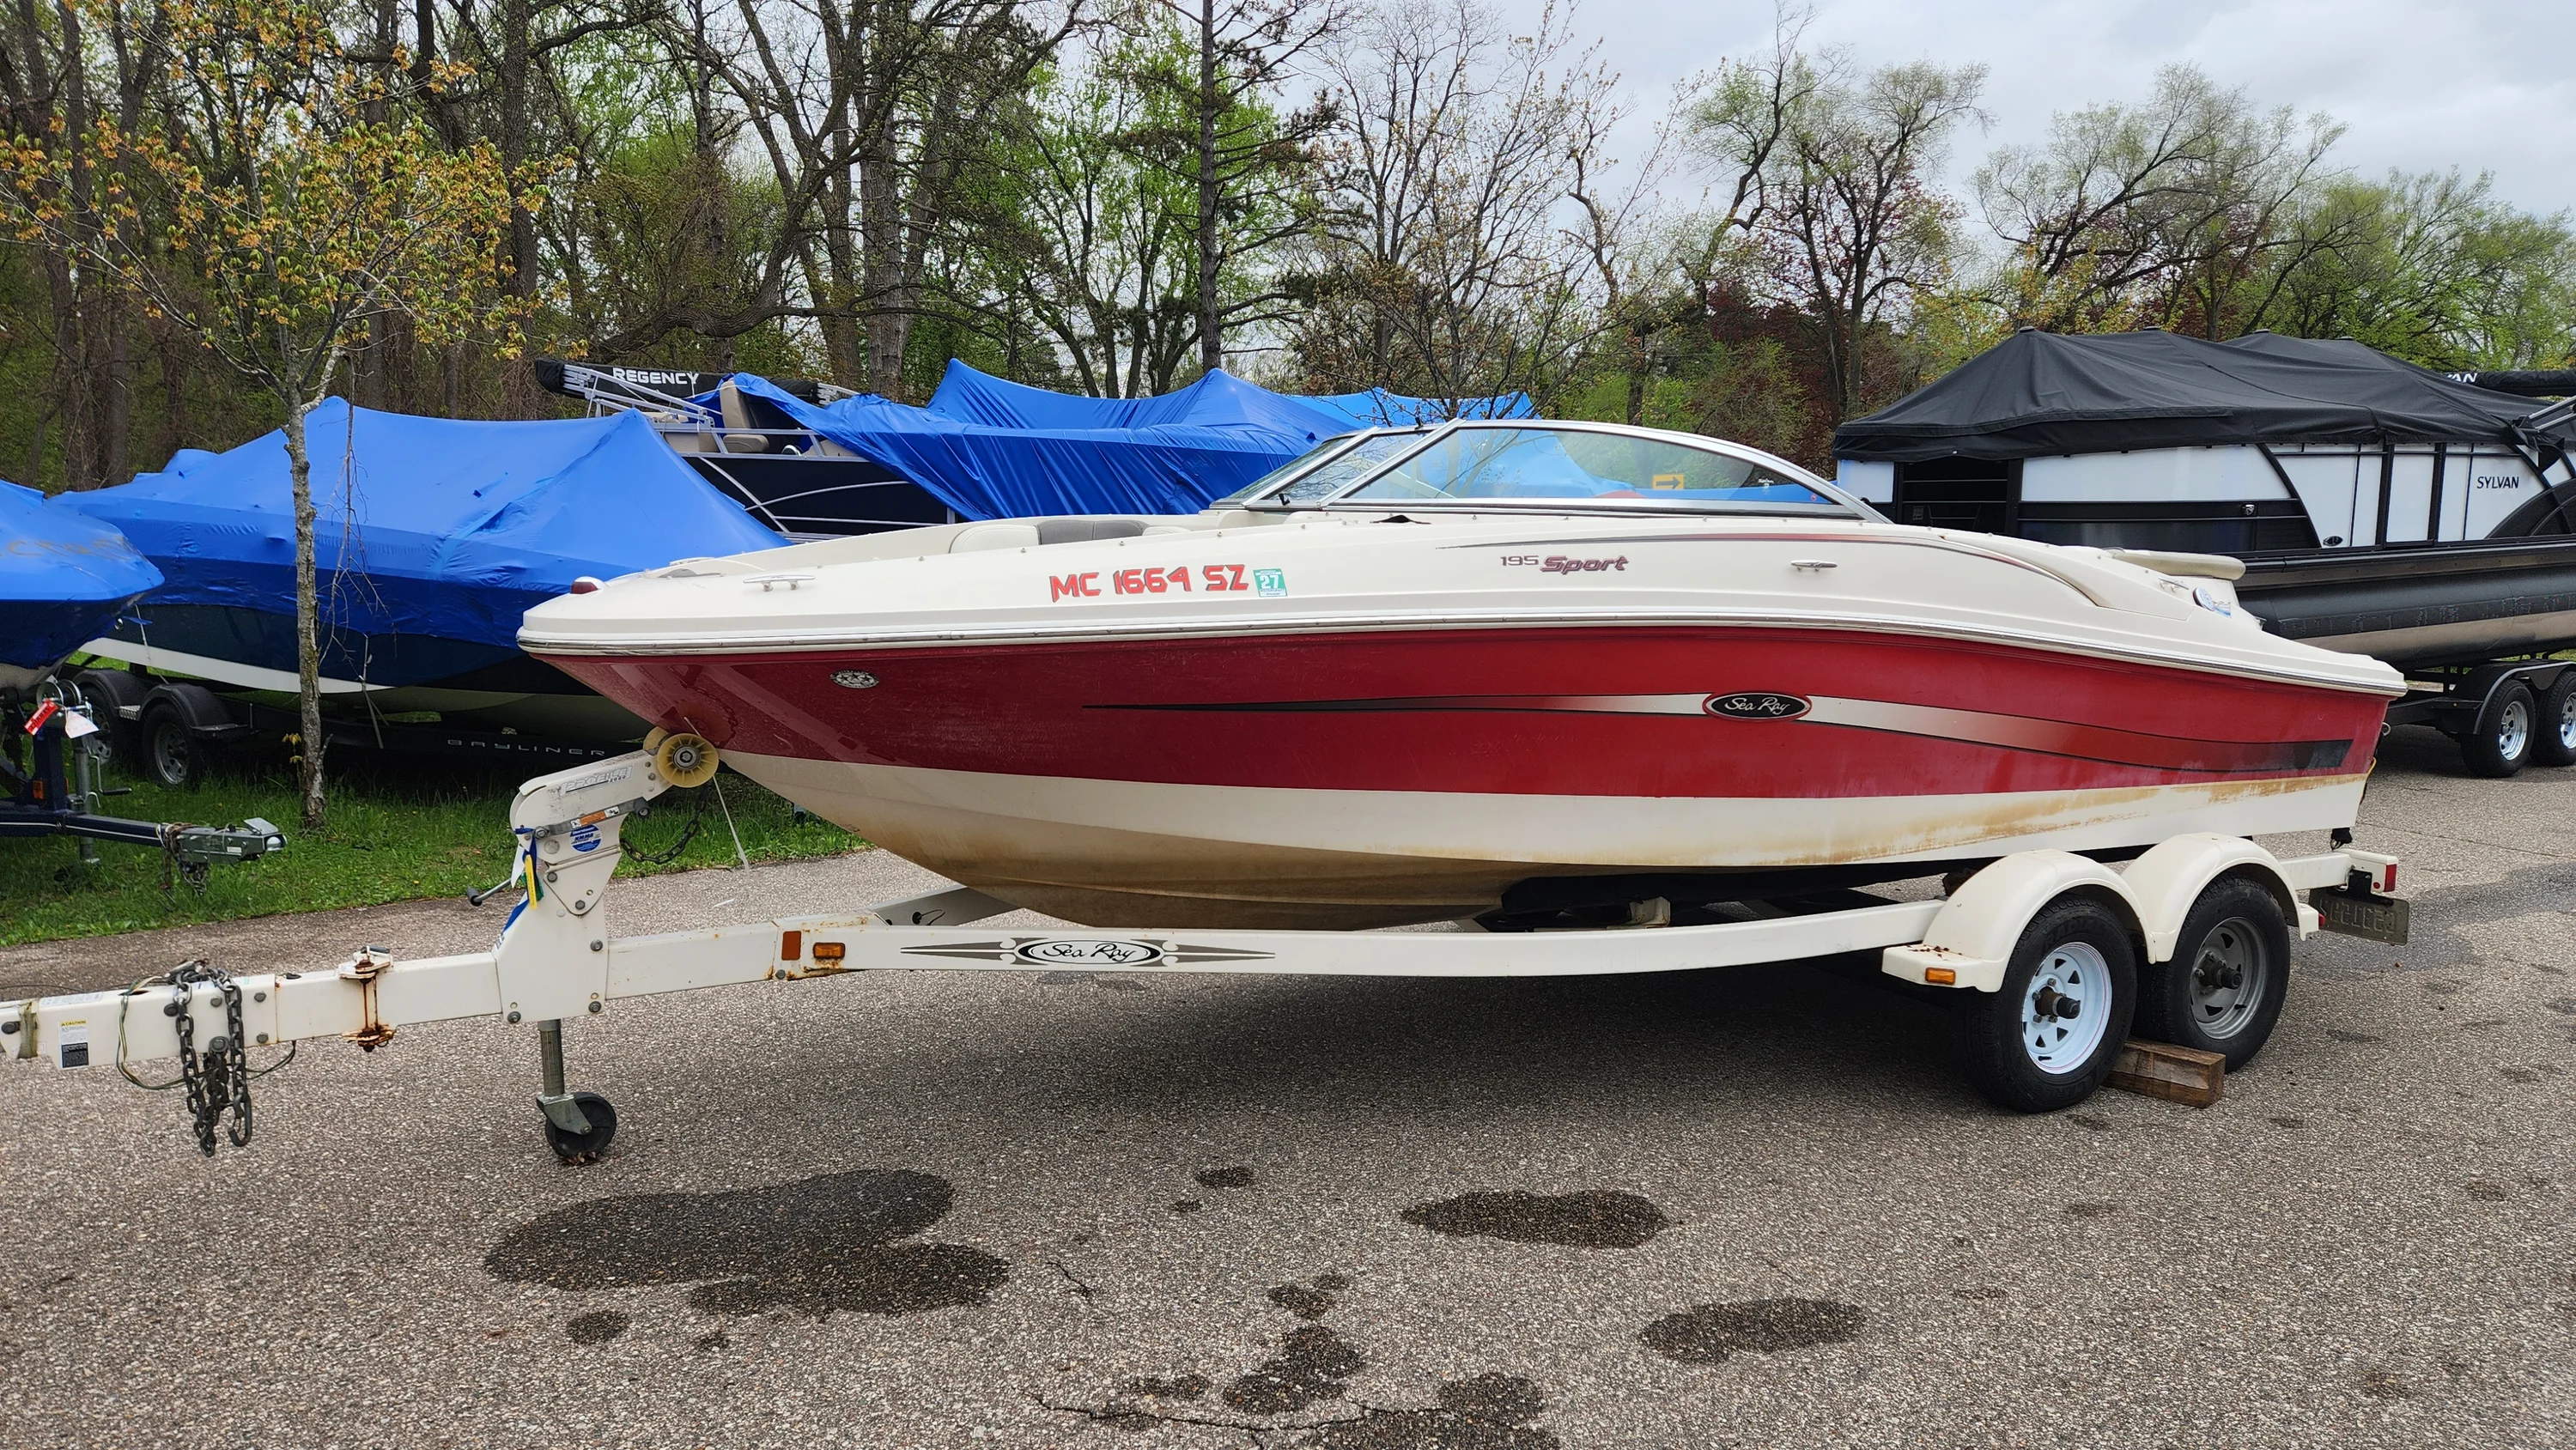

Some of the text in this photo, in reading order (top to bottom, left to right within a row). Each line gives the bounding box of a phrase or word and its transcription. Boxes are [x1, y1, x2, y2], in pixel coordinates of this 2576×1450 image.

[612, 367, 699, 385] REGENCY
[2476, 476, 2519, 489] SYLVAN
[1500, 555, 1629, 575] 195 Sport
[1049, 564, 1249, 604] MC 1664 SZ
[1259, 574, 1279, 590] 27
[1724, 696, 1790, 715] Sea Ray
[447, 739, 605, 756] BAYLINER
[565, 767, 629, 791] PROFILE
[1042, 943, 1137, 962] Sea Ray
